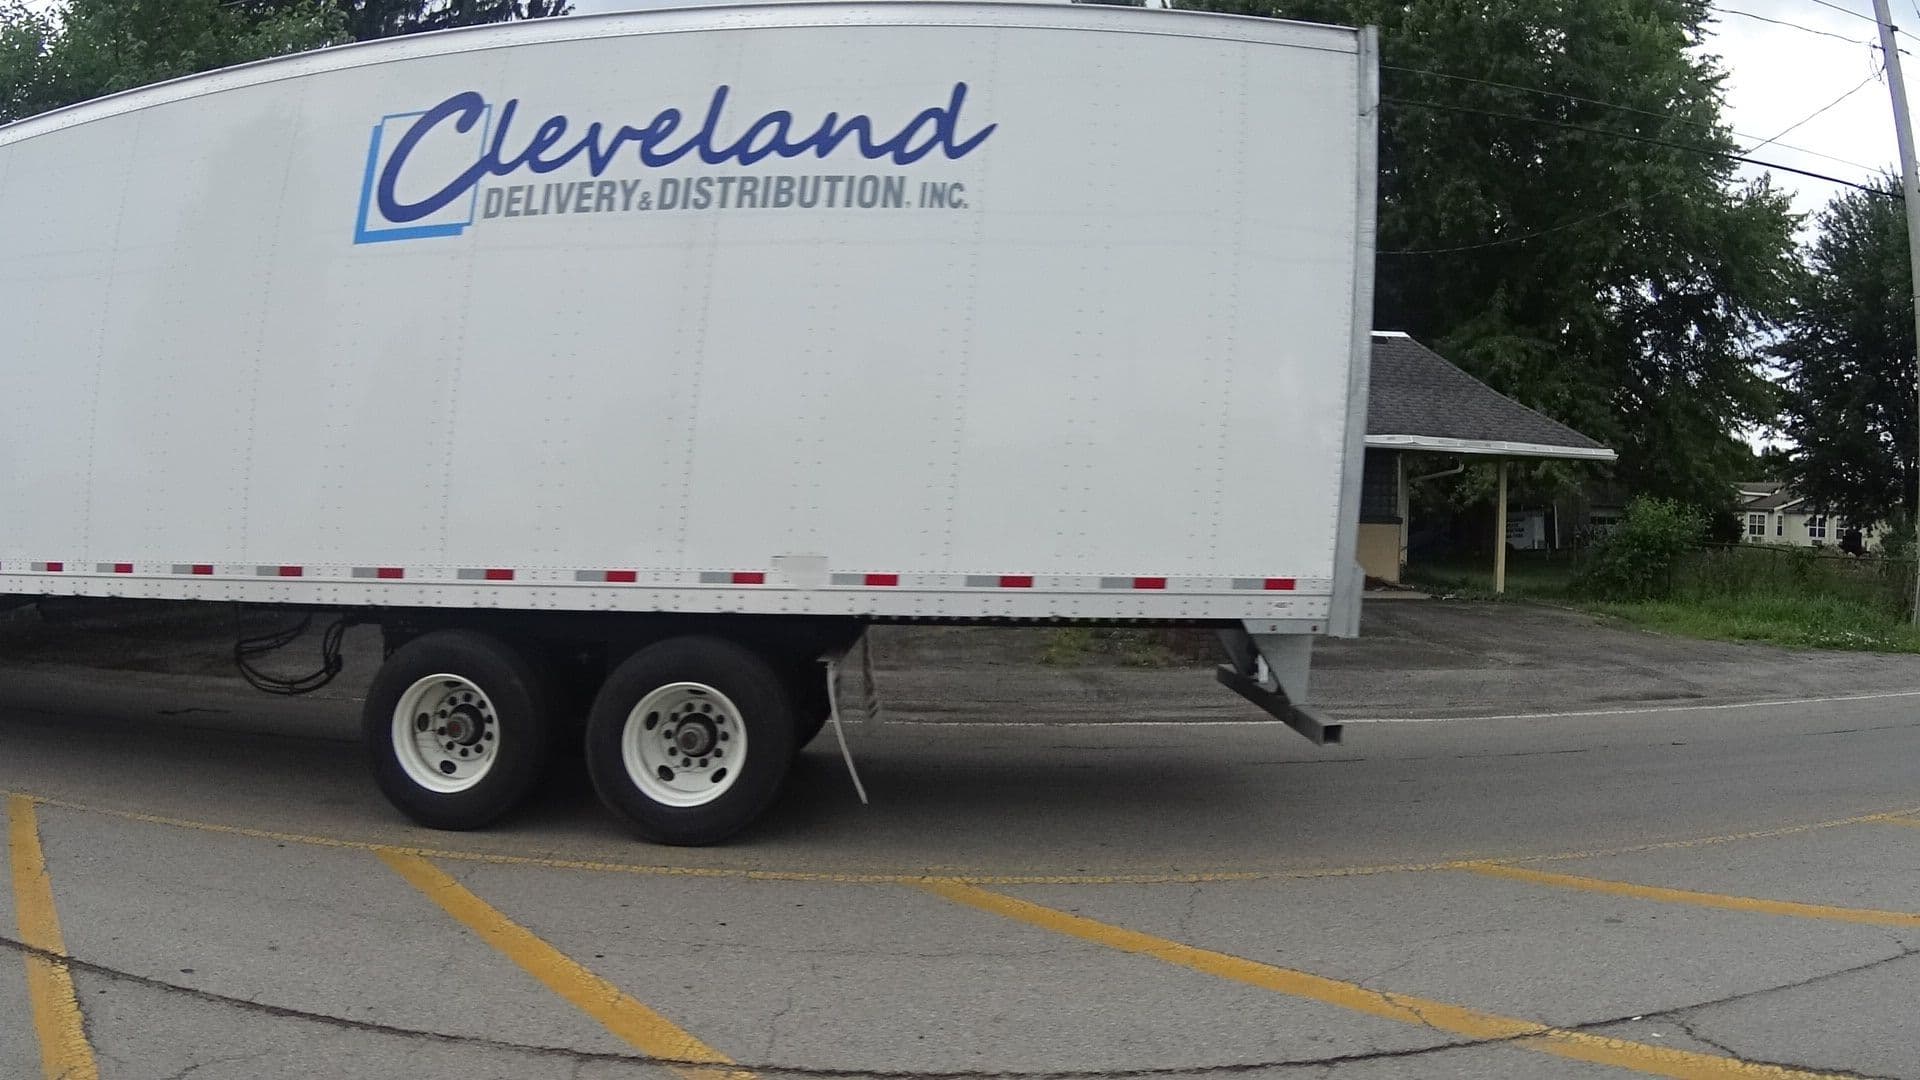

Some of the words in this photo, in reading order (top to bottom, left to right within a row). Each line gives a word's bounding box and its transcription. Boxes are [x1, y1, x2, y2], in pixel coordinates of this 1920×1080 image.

[377, 81, 999, 224] Cleveland
[482, 178, 640, 219] DELIVERY
[637, 191, 653, 211] &
[919, 181, 970, 210] INC.
